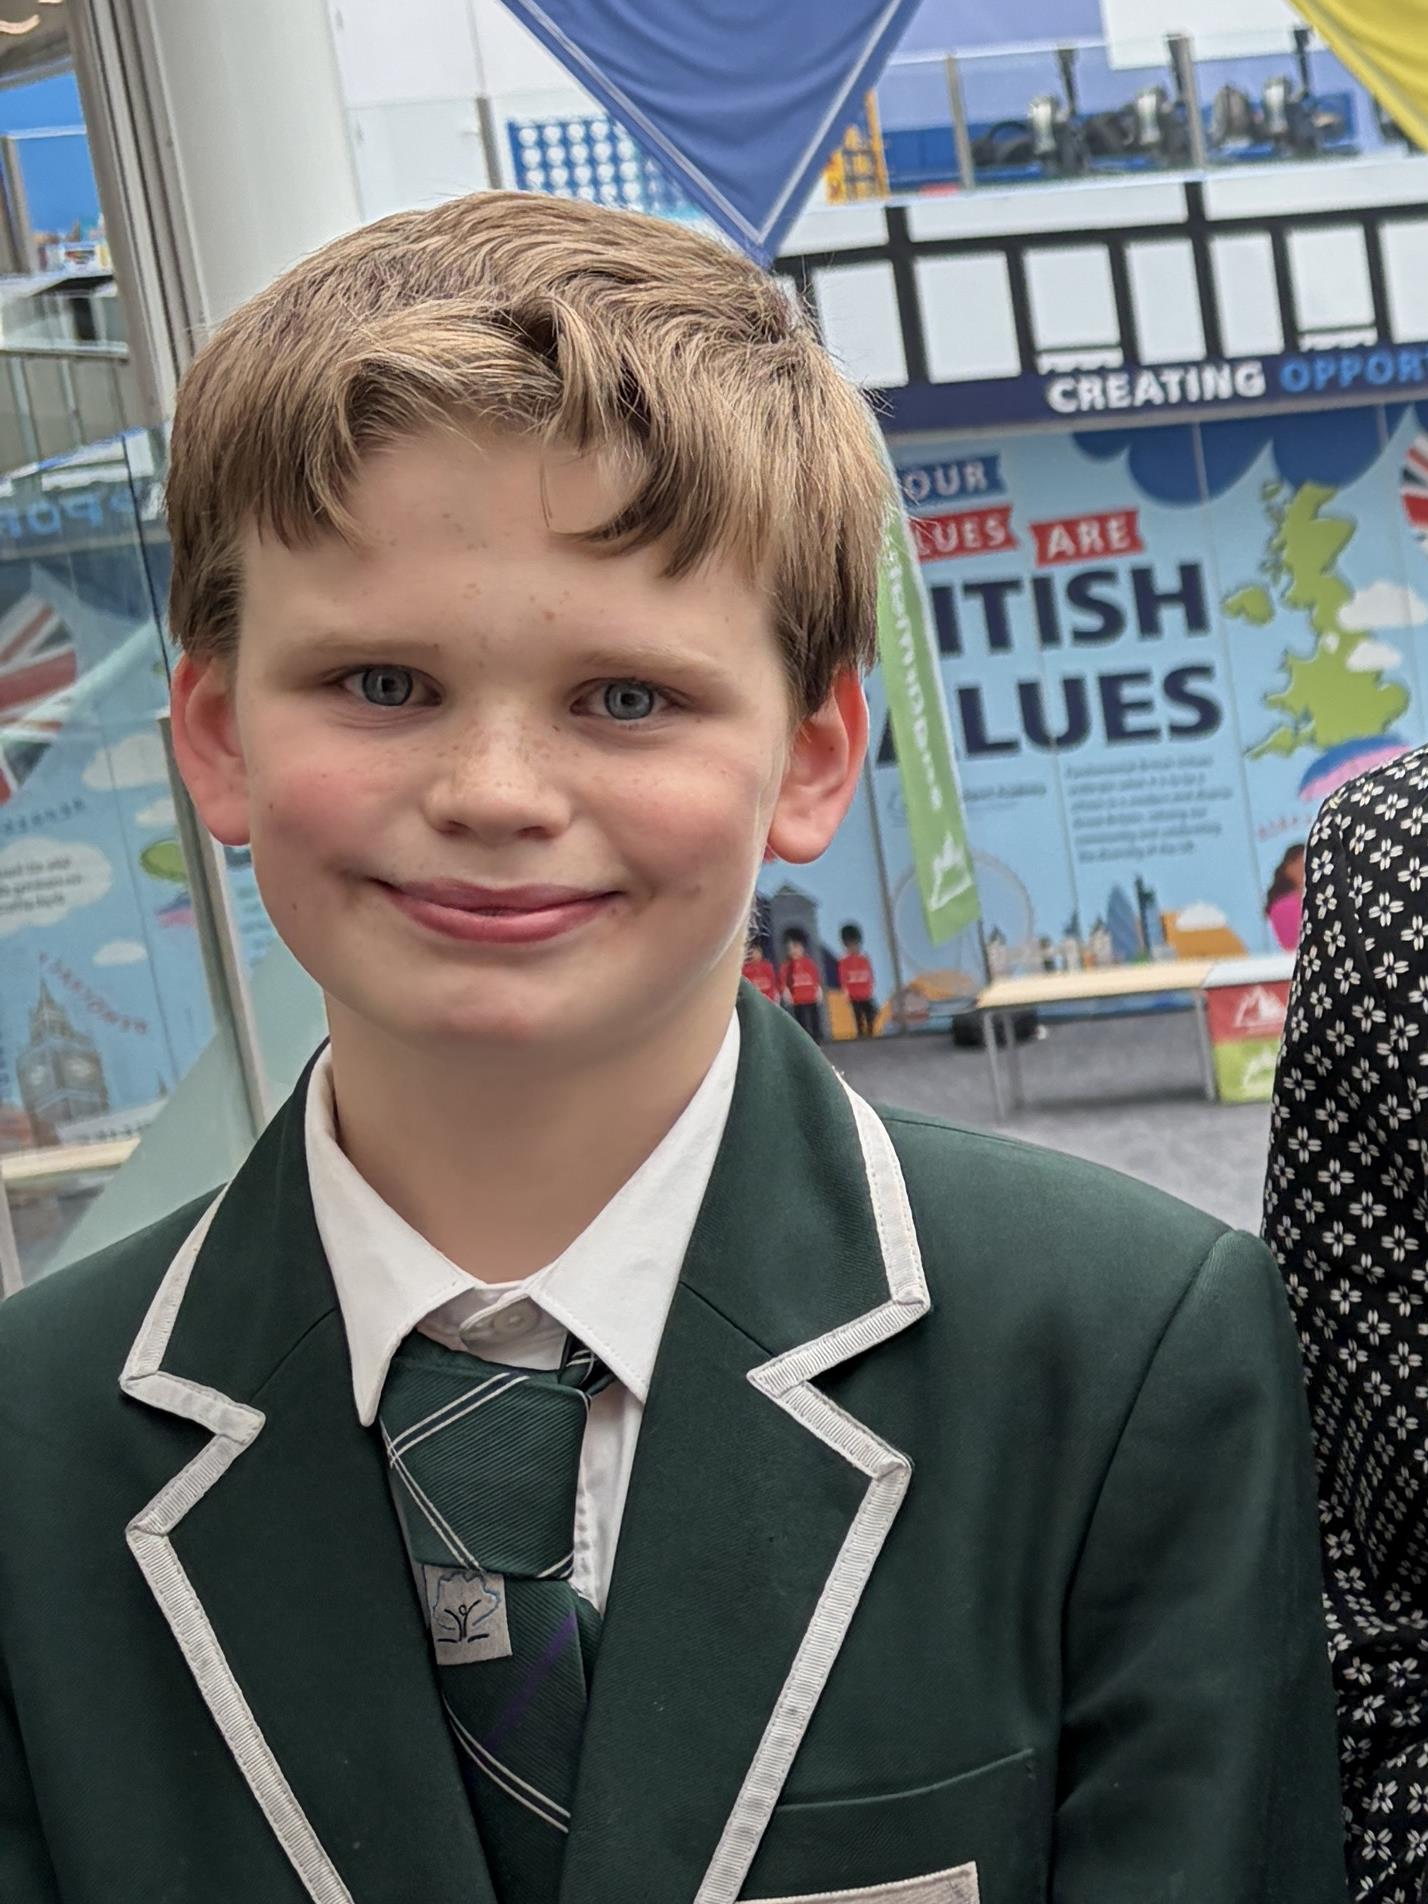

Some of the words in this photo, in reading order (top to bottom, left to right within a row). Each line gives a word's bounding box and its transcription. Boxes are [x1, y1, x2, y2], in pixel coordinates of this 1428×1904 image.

[1045, 361, 1267, 416] CREATING
[911, 516, 1006, 557] LUES
[1047, 515, 1132, 559] ARE
[930, 563, 1210, 658] ITISH
[877, 664, 1223, 764] LUES
